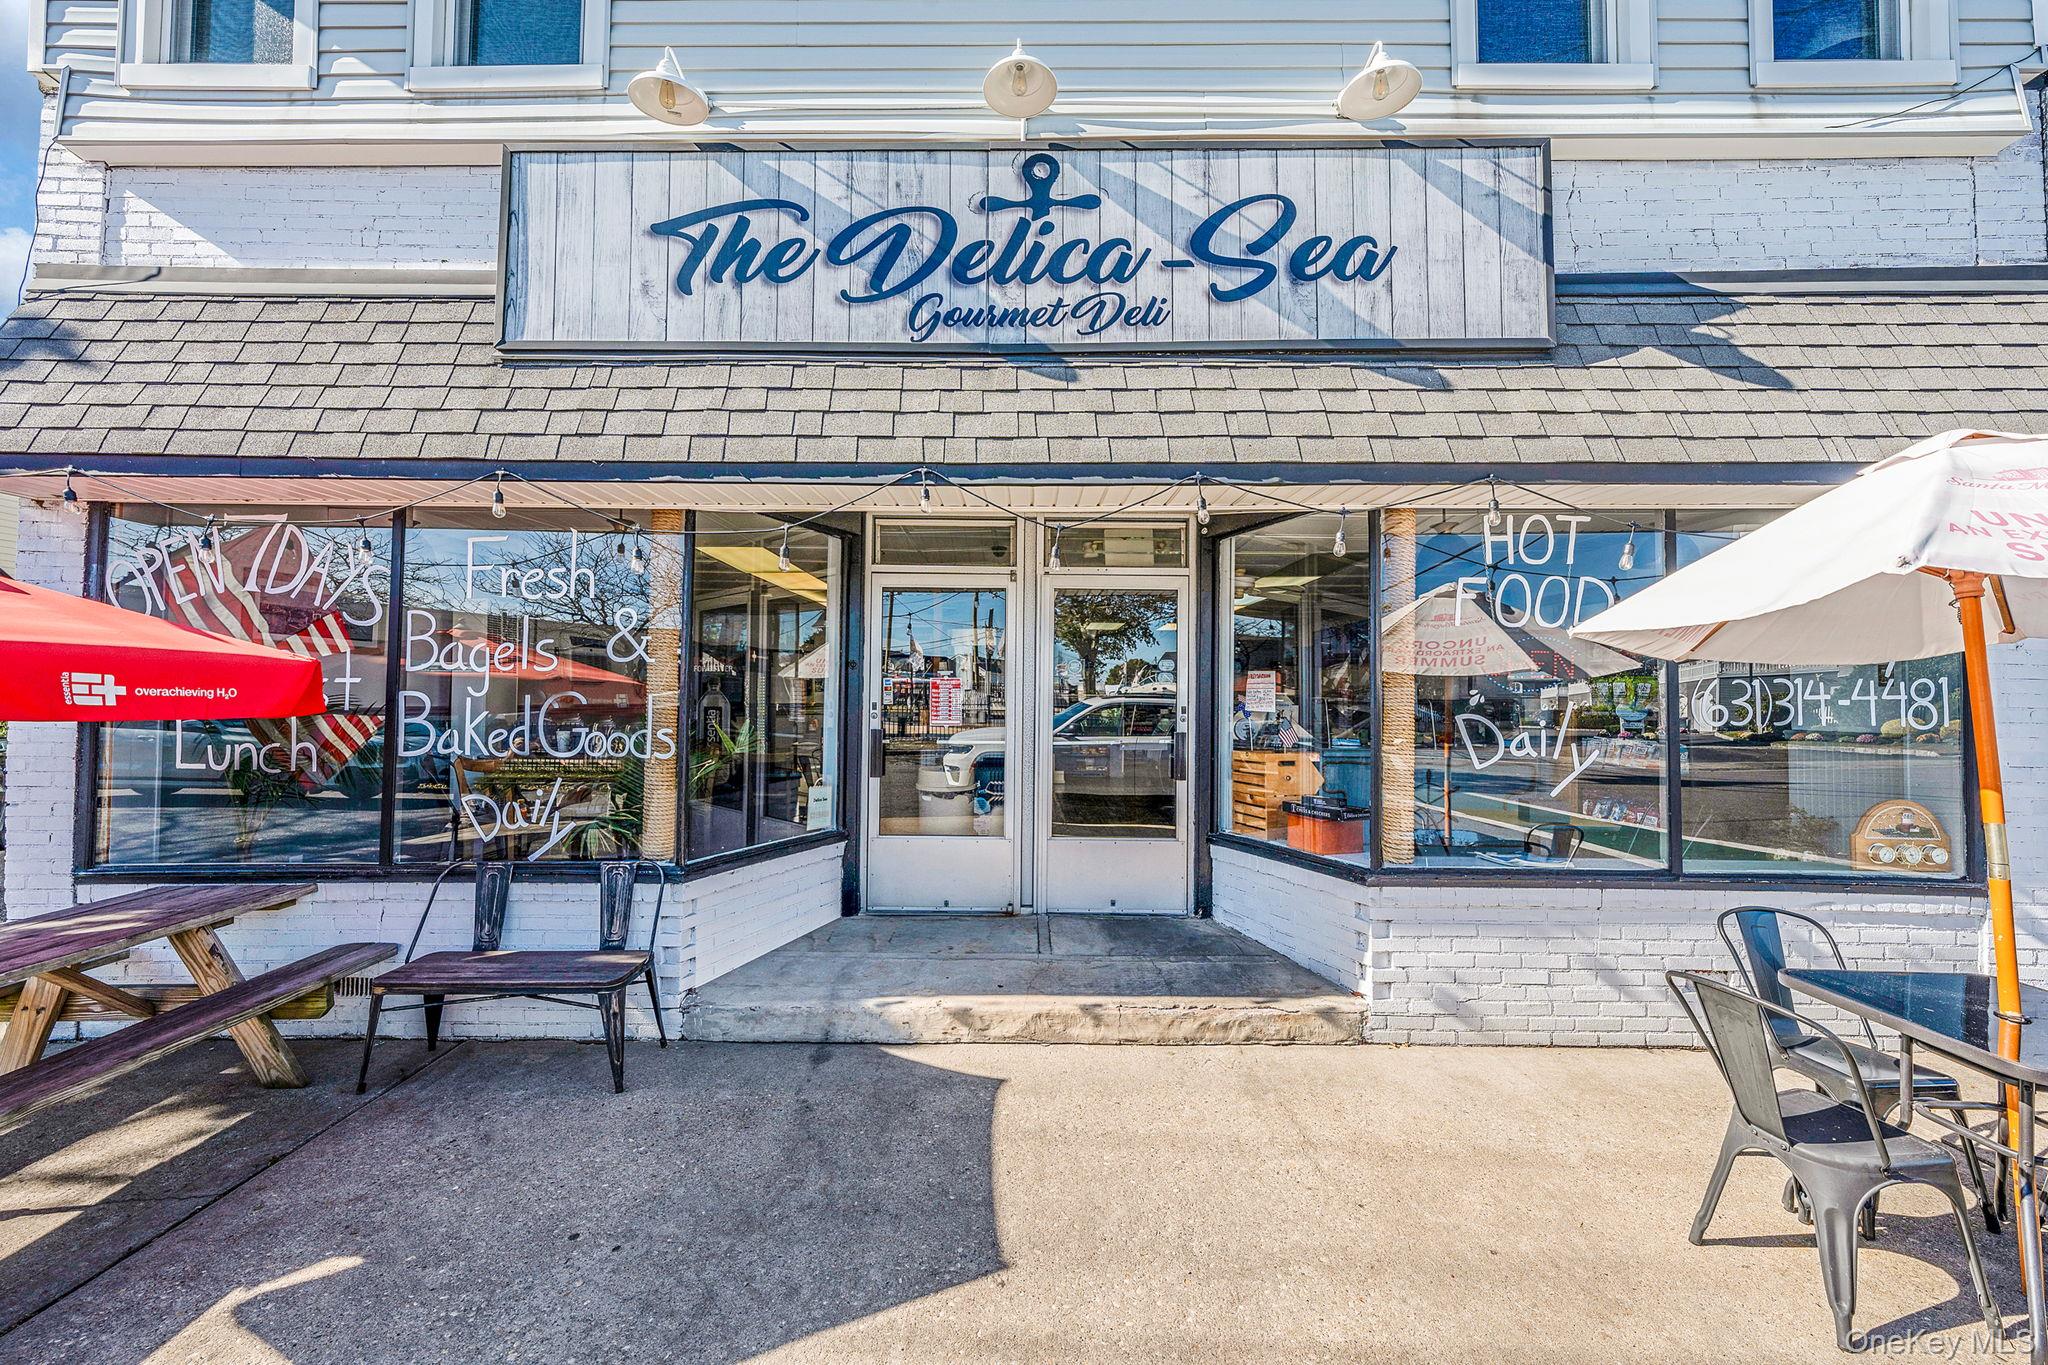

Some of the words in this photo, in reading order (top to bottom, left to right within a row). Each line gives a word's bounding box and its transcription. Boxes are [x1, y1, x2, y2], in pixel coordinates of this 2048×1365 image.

[650, 199, 821, 296] The
[908, 292, 1068, 342] Gourmet
[1071, 292, 1171, 335] Deli
[1483, 514, 1592, 565] HOT
[1949, 522, 1993, 538] AN
[2002, 529, 2048, 542] EX
[105, 525, 225, 616] OPEN
[264, 524, 393, 627] DAYS
[466, 527, 596, 599] Fresh
[1455, 574, 1615, 628] FOOD
[405, 610, 559, 695] Bagels
[606, 607, 656, 663] &
[60, 671, 71, 705] essentia
[135, 686, 215, 699] overachieving
[1691, 676, 1950, 734] (631)314-4481
[175, 716, 317, 774] Lunch
[1454, 701, 1600, 797] Daily
[460, 777, 577, 862] Daily
